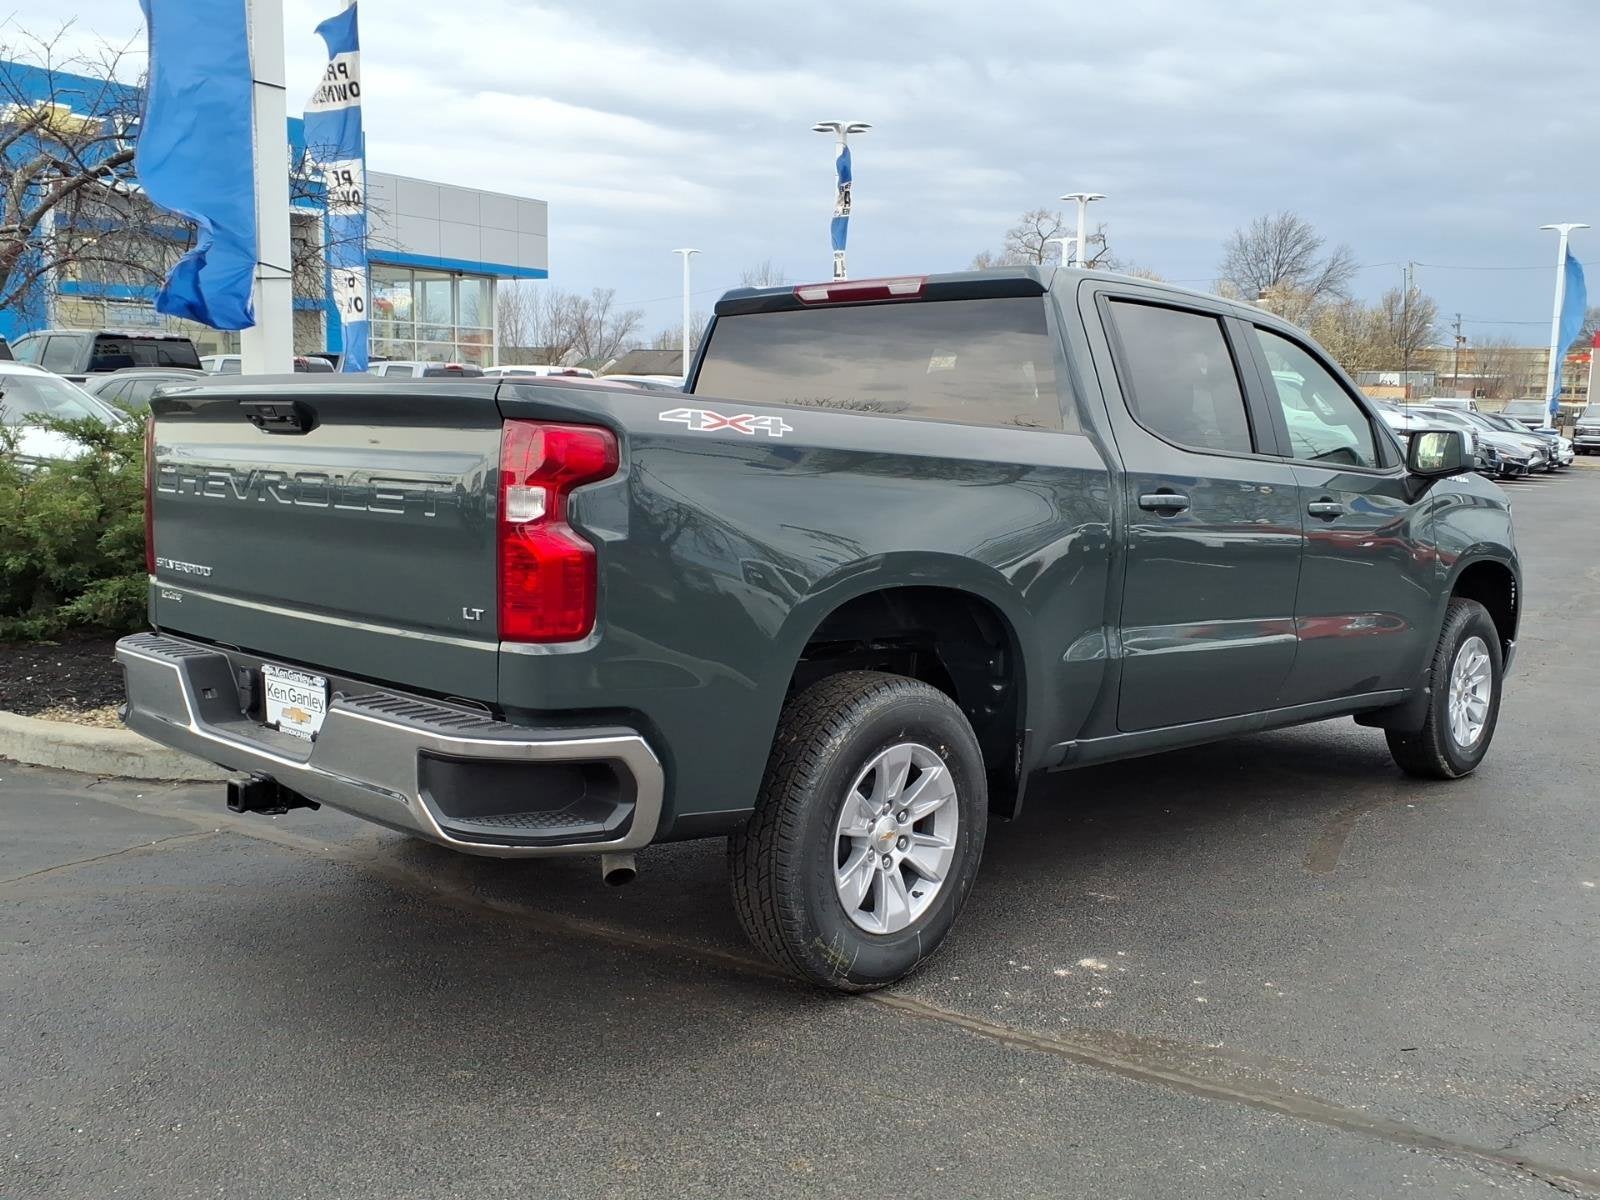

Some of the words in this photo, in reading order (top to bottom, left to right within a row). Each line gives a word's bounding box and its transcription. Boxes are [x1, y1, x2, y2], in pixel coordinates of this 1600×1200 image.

[157, 463, 453, 517] CHEVROLET
[156, 557, 213, 577] SILVERADO
[462, 607, 485, 621] LT
[275, 666, 289, 680] Ken
[266, 681, 287, 699] Ken
[288, 688, 325, 714] Ganley
